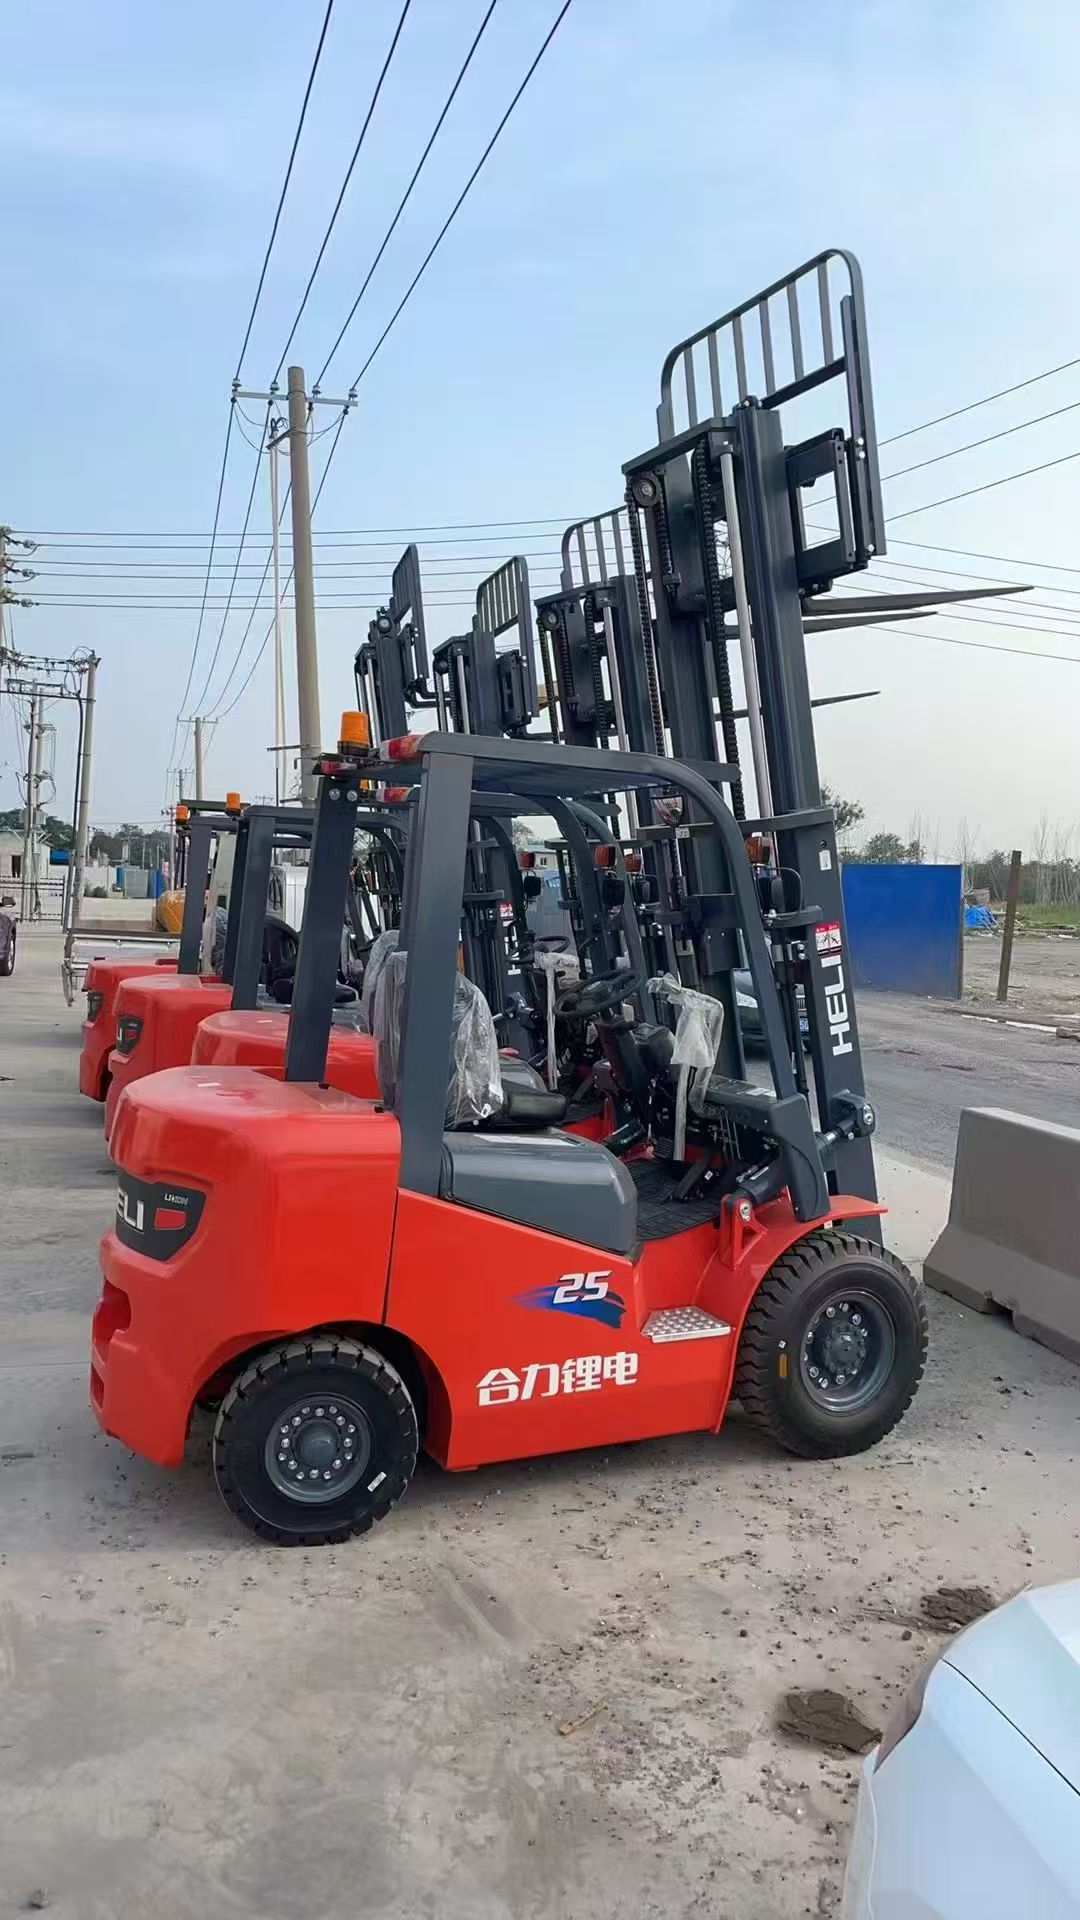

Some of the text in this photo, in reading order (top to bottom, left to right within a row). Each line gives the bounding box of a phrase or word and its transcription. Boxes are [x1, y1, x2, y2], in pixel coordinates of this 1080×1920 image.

[821, 954, 853, 1056] HELI
[117, 1186, 144, 1231] ELI
[553, 1270, 612, 1304] 25
[476, 1351, 639, 1406] 合力锂电
